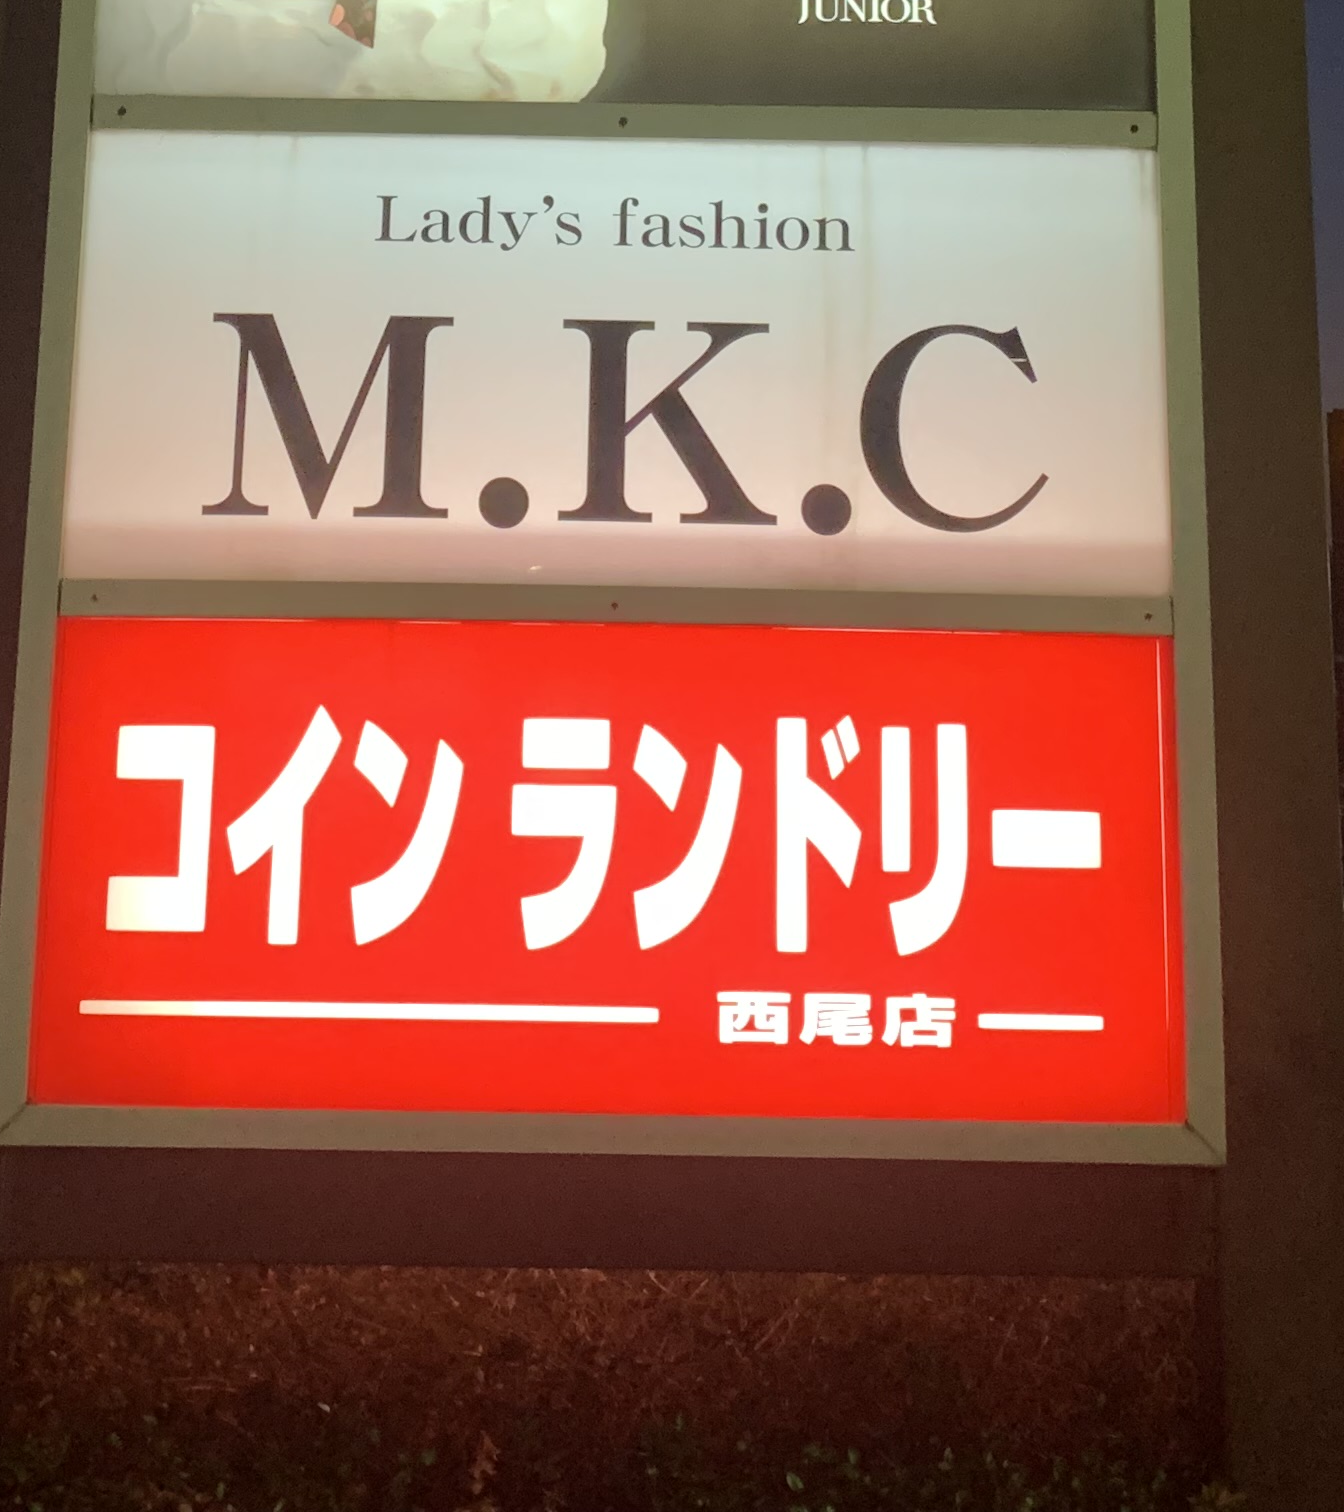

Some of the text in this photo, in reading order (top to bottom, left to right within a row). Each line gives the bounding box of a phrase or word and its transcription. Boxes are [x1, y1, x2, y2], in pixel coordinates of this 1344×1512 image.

[614, 197, 855, 252] fashion
[201, 312, 1049, 536] M.K.C
[106, 704, 1102, 957] コインランドリー
[716, 991, 956, 1048] 西尾店
